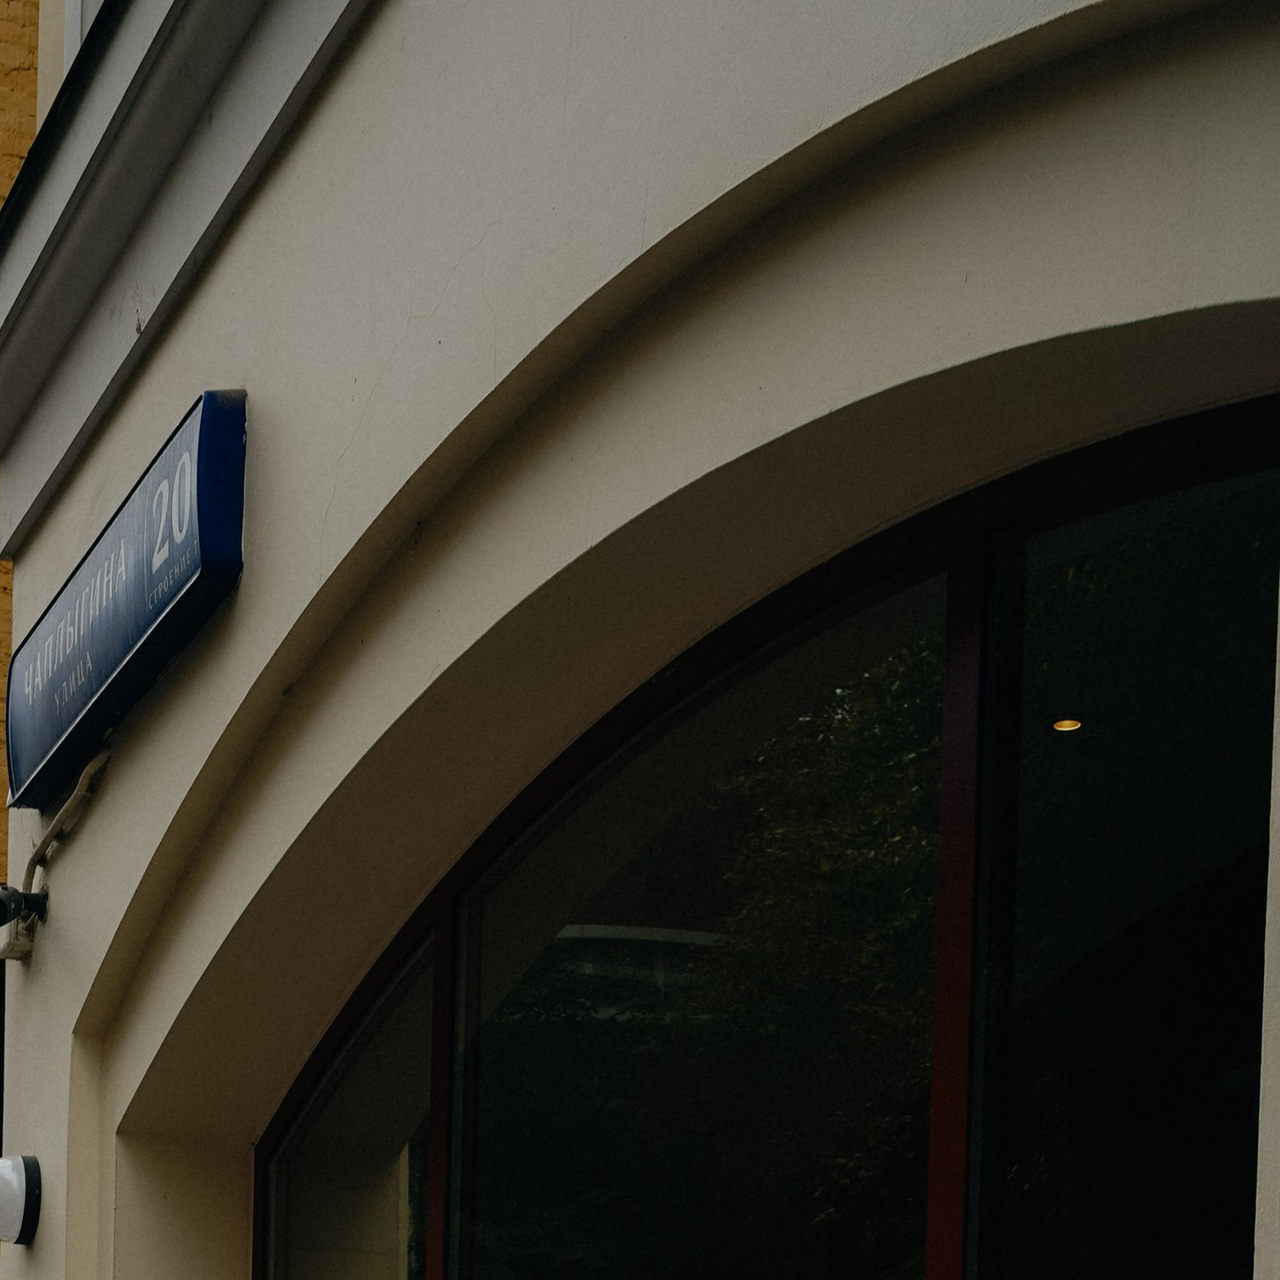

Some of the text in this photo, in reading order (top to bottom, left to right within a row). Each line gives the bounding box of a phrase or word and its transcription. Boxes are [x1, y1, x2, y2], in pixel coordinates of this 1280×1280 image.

[152, 451, 191, 576] 20
[24, 538, 127, 706] ЧАПЛЫГИНА
[148, 546, 192, 611] СТРОЕНИЕ
[54, 651, 93, 714] УЛИЦА
